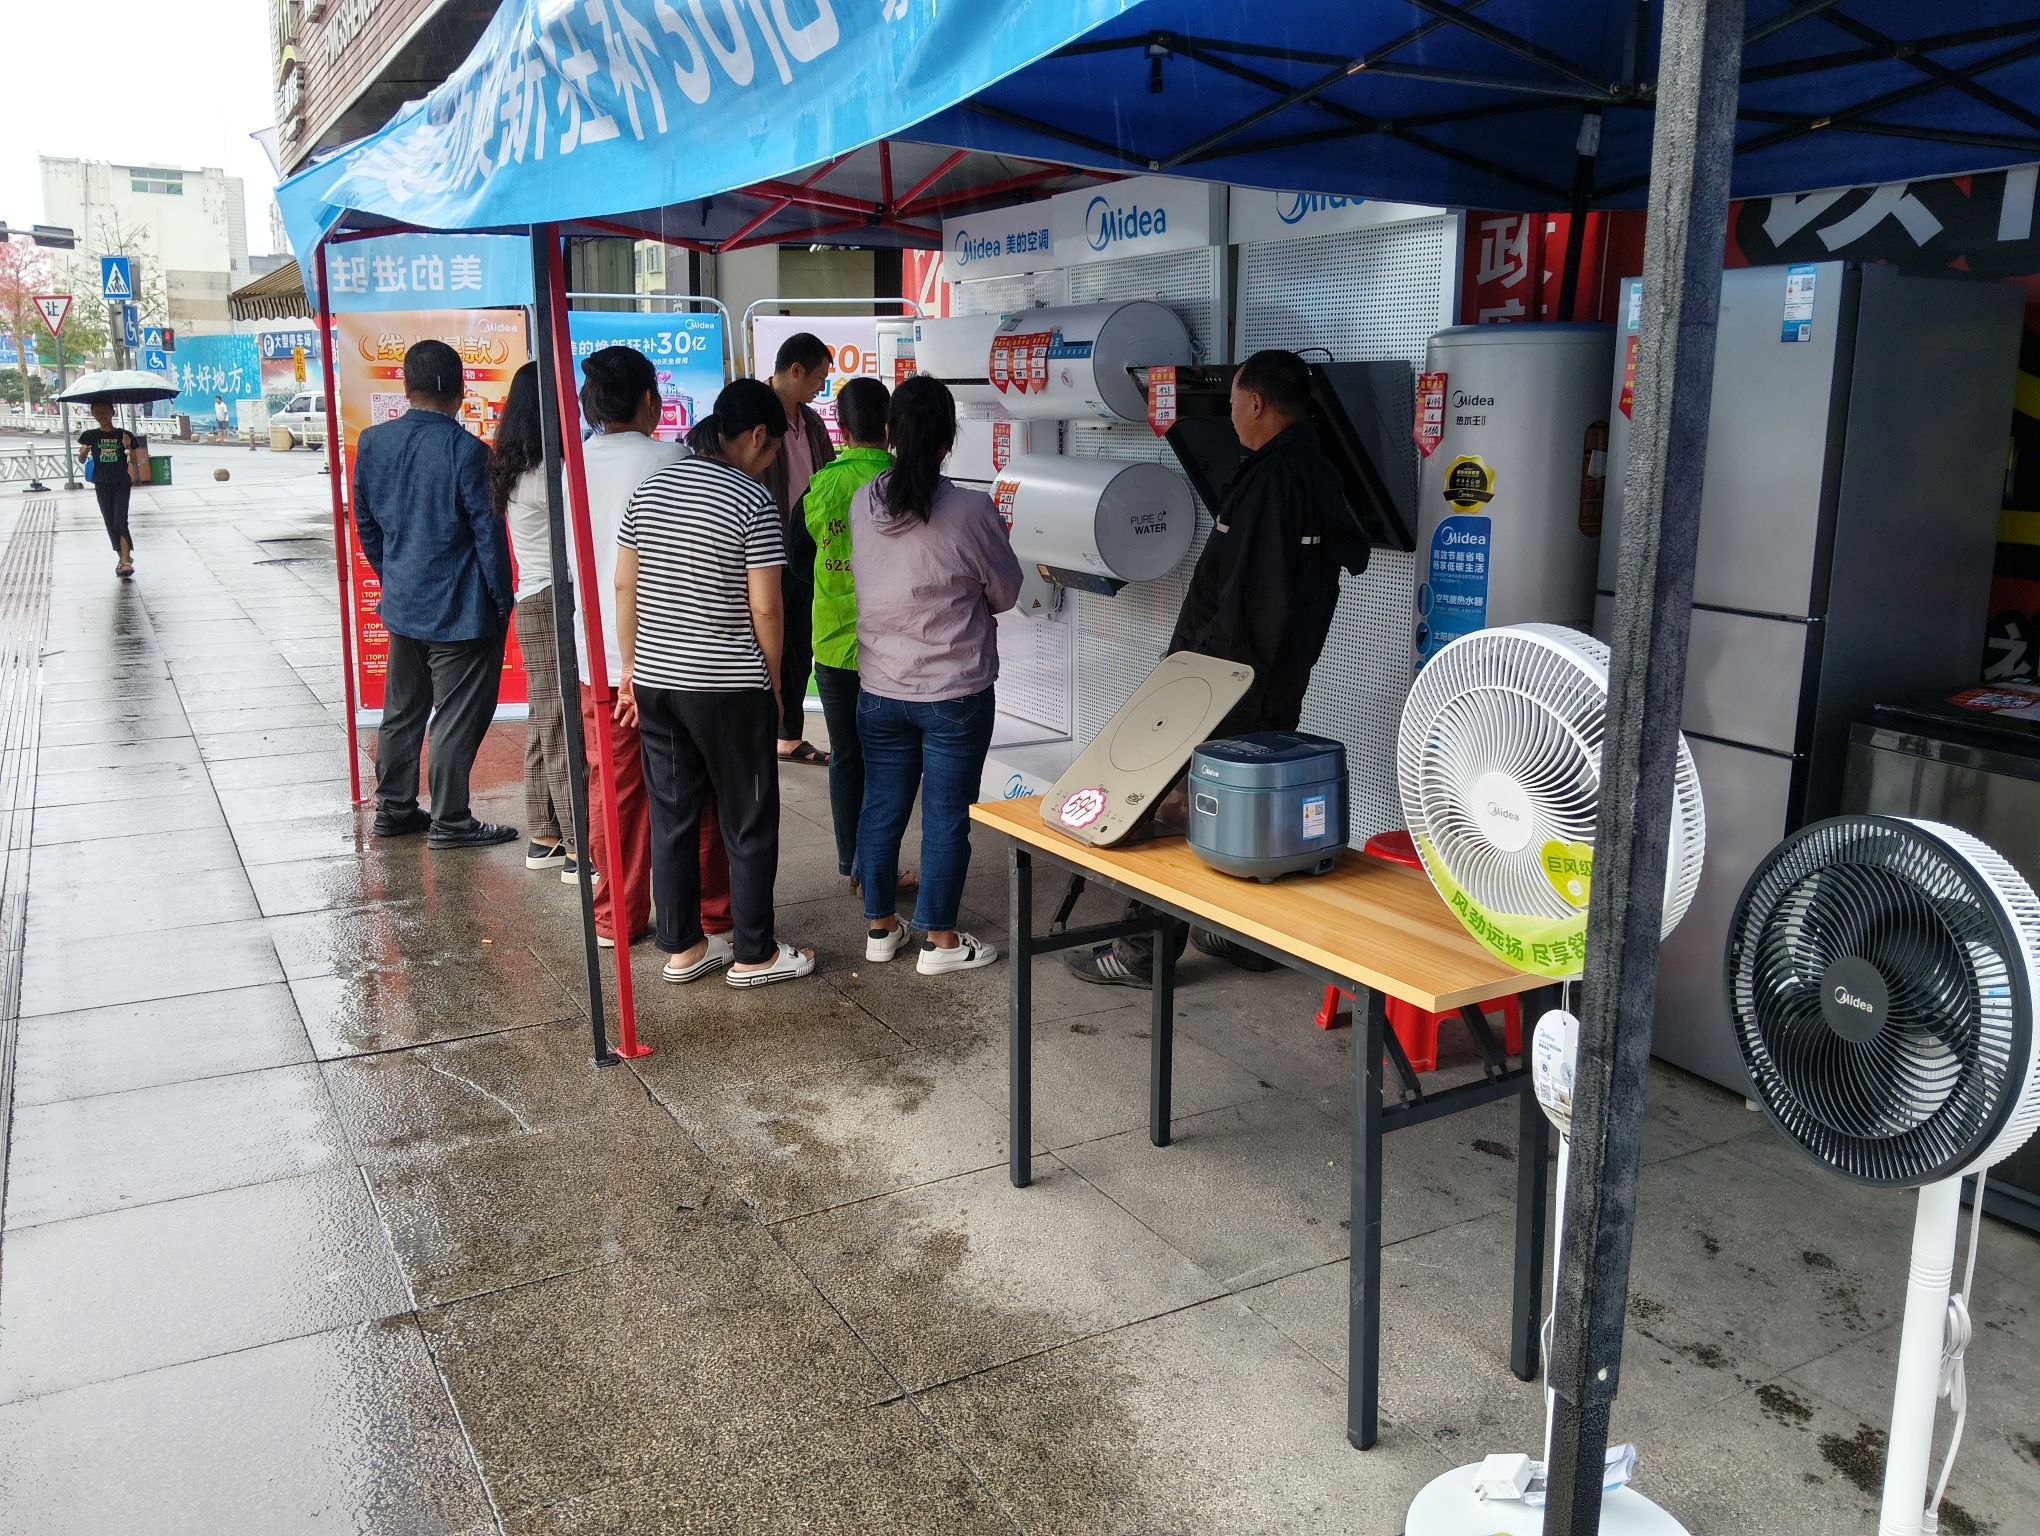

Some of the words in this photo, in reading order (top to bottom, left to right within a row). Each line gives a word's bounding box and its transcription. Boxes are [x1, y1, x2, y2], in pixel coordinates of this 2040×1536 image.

[1086, 196, 1167, 252] Midea
[955, 230, 1001, 267] Midea
[1006, 228, 1049, 256] 美的空调
[46, 301, 60, 316] 让
[479, 319, 517, 333] Midea
[685, 319, 715, 330] Midea
[275, 333, 312, 348] 大型停车场
[1452, 390, 1494, 408] Midea
[1131, 514, 1154, 526] PURE
[1134, 523, 1167, 535] WATER
[1441, 526, 1486, 546] Midea
[1433, 550, 1484, 562] 高效节能省电
[1433, 561, 1484, 573] 畅享低碳生活
[1435, 594, 1484, 607] 空气能热水器
[1065, 796, 1097, 821] 599
[1488, 801, 1520, 821] Midea
[1452, 890, 1524, 962] 风劲远扬
[1834, 985, 1873, 1014] Midea
